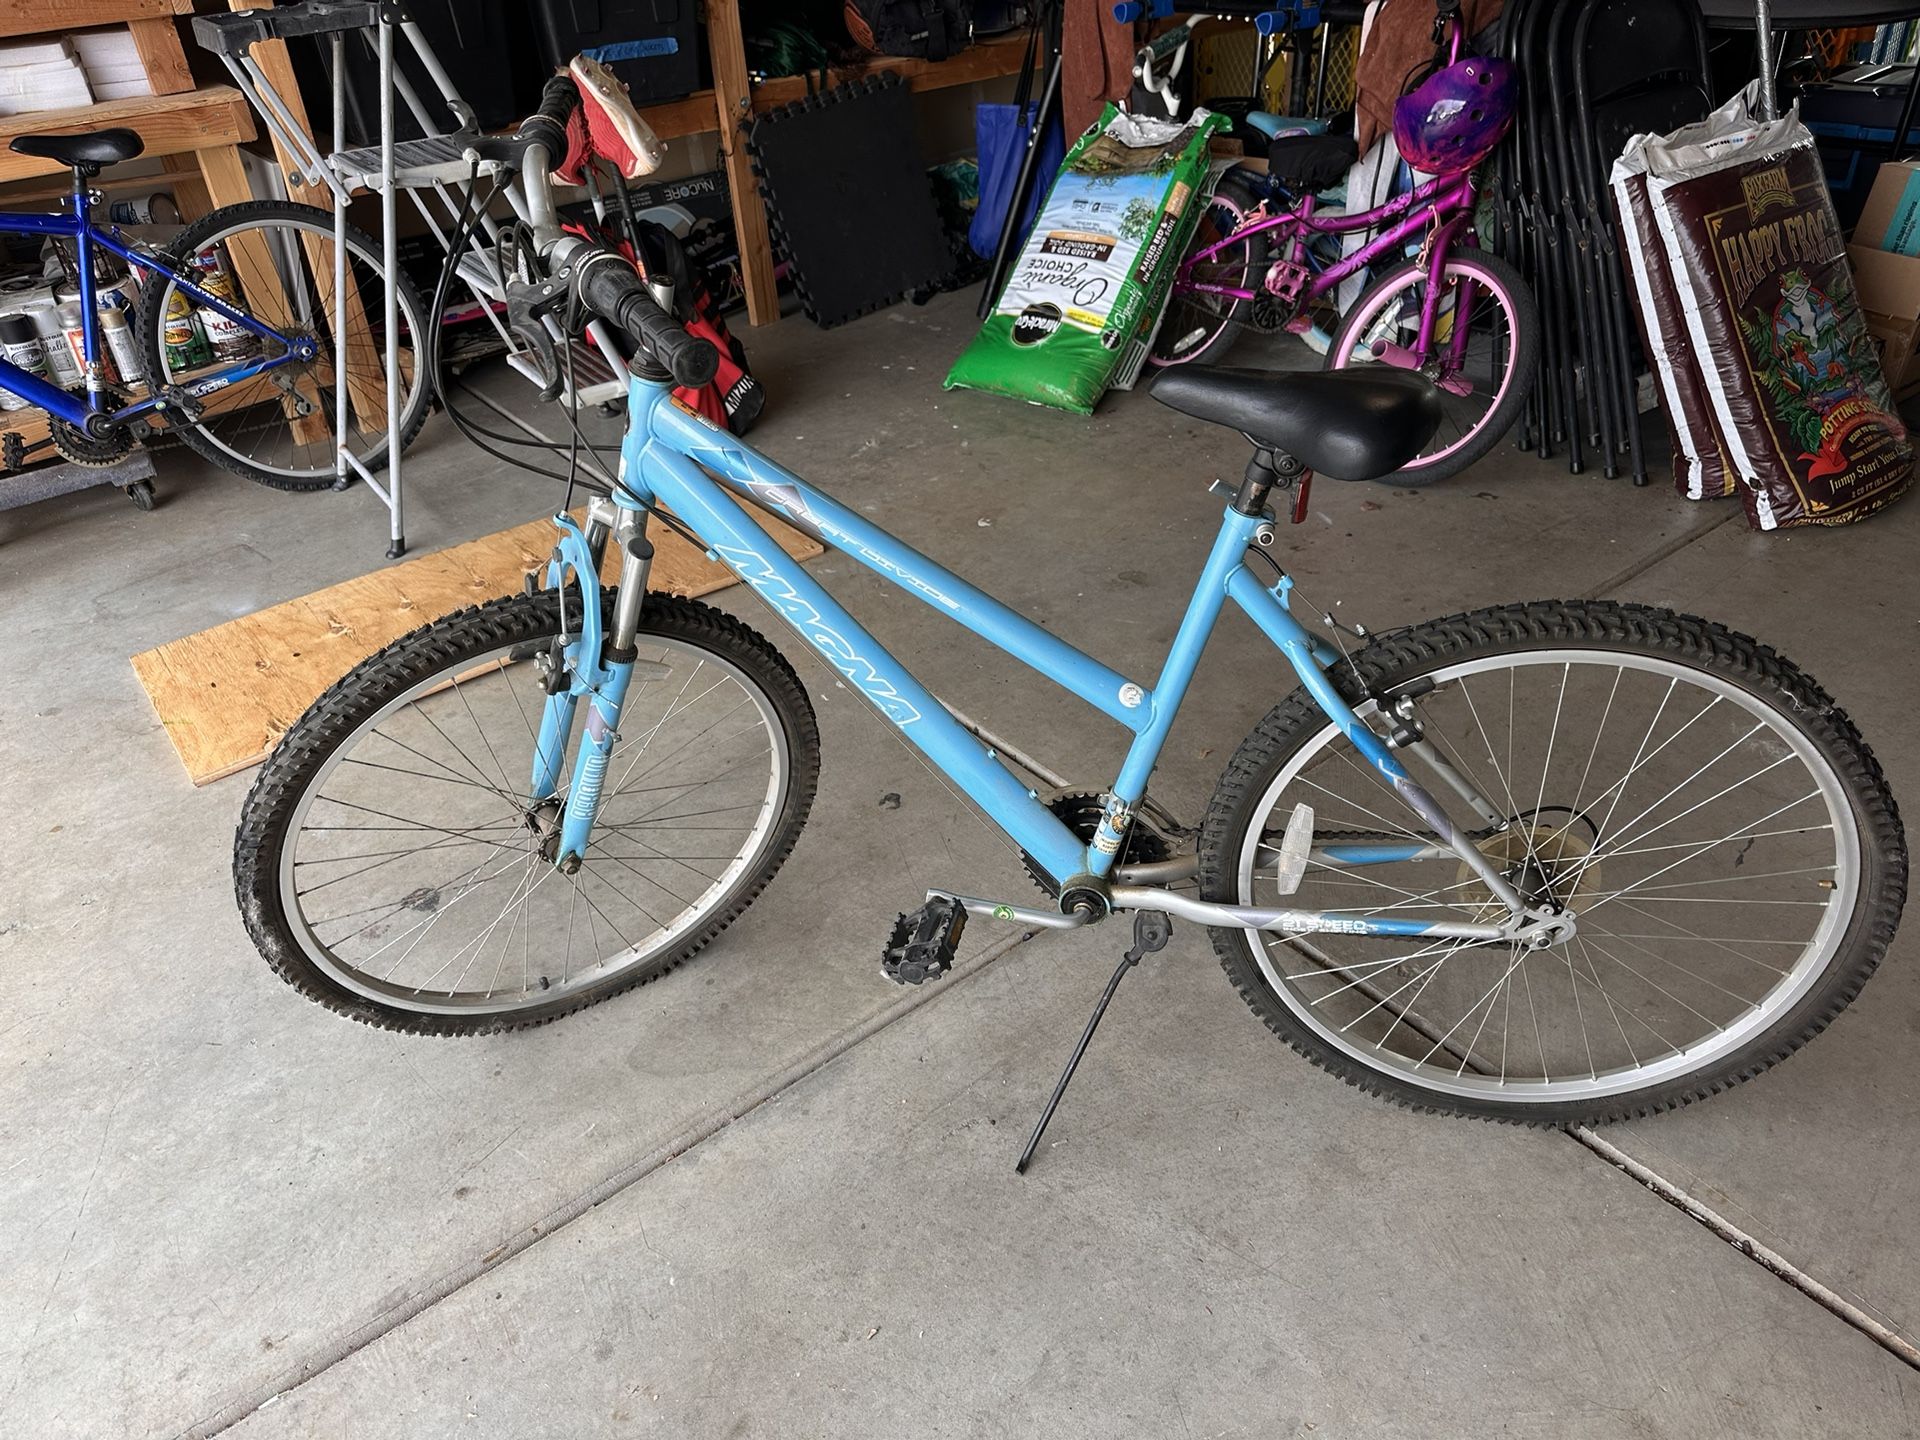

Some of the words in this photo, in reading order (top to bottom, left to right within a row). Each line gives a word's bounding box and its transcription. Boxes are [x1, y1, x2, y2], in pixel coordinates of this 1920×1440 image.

[1027, 259, 1074, 274] CHOICE
[1070, 247, 1098, 258] RAISED
[1140, 246, 1158, 273] RAISED
[1152, 229, 1165, 246] BED
[1142, 237, 1168, 283] IN-GROUND
[1164, 219, 1177, 237] SOIL
[1721, 221, 1788, 309] HAPPY
[1782, 209, 1840, 266] FROG
[172, 273, 215, 301] CANTILEVER
[215, 298, 245, 317] BRAKES
[1021, 261, 1109, 307] Organic
[211, 320, 238, 332] KIL
[214, 326, 248, 338] COMPLET
[726, 373, 757, 412] MIZUN
[1820, 401, 1860, 441] POTTING
[1829, 471, 1857, 495] Jump
[1856, 457, 1882, 479] Start
[1878, 449, 1897, 466] Your
[765, 489, 863, 549] GREAT
[860, 547, 961, 611] DIVIDE
[714, 543, 922, 729] MAGNA
[1306, 918, 1367, 932] SPEED
